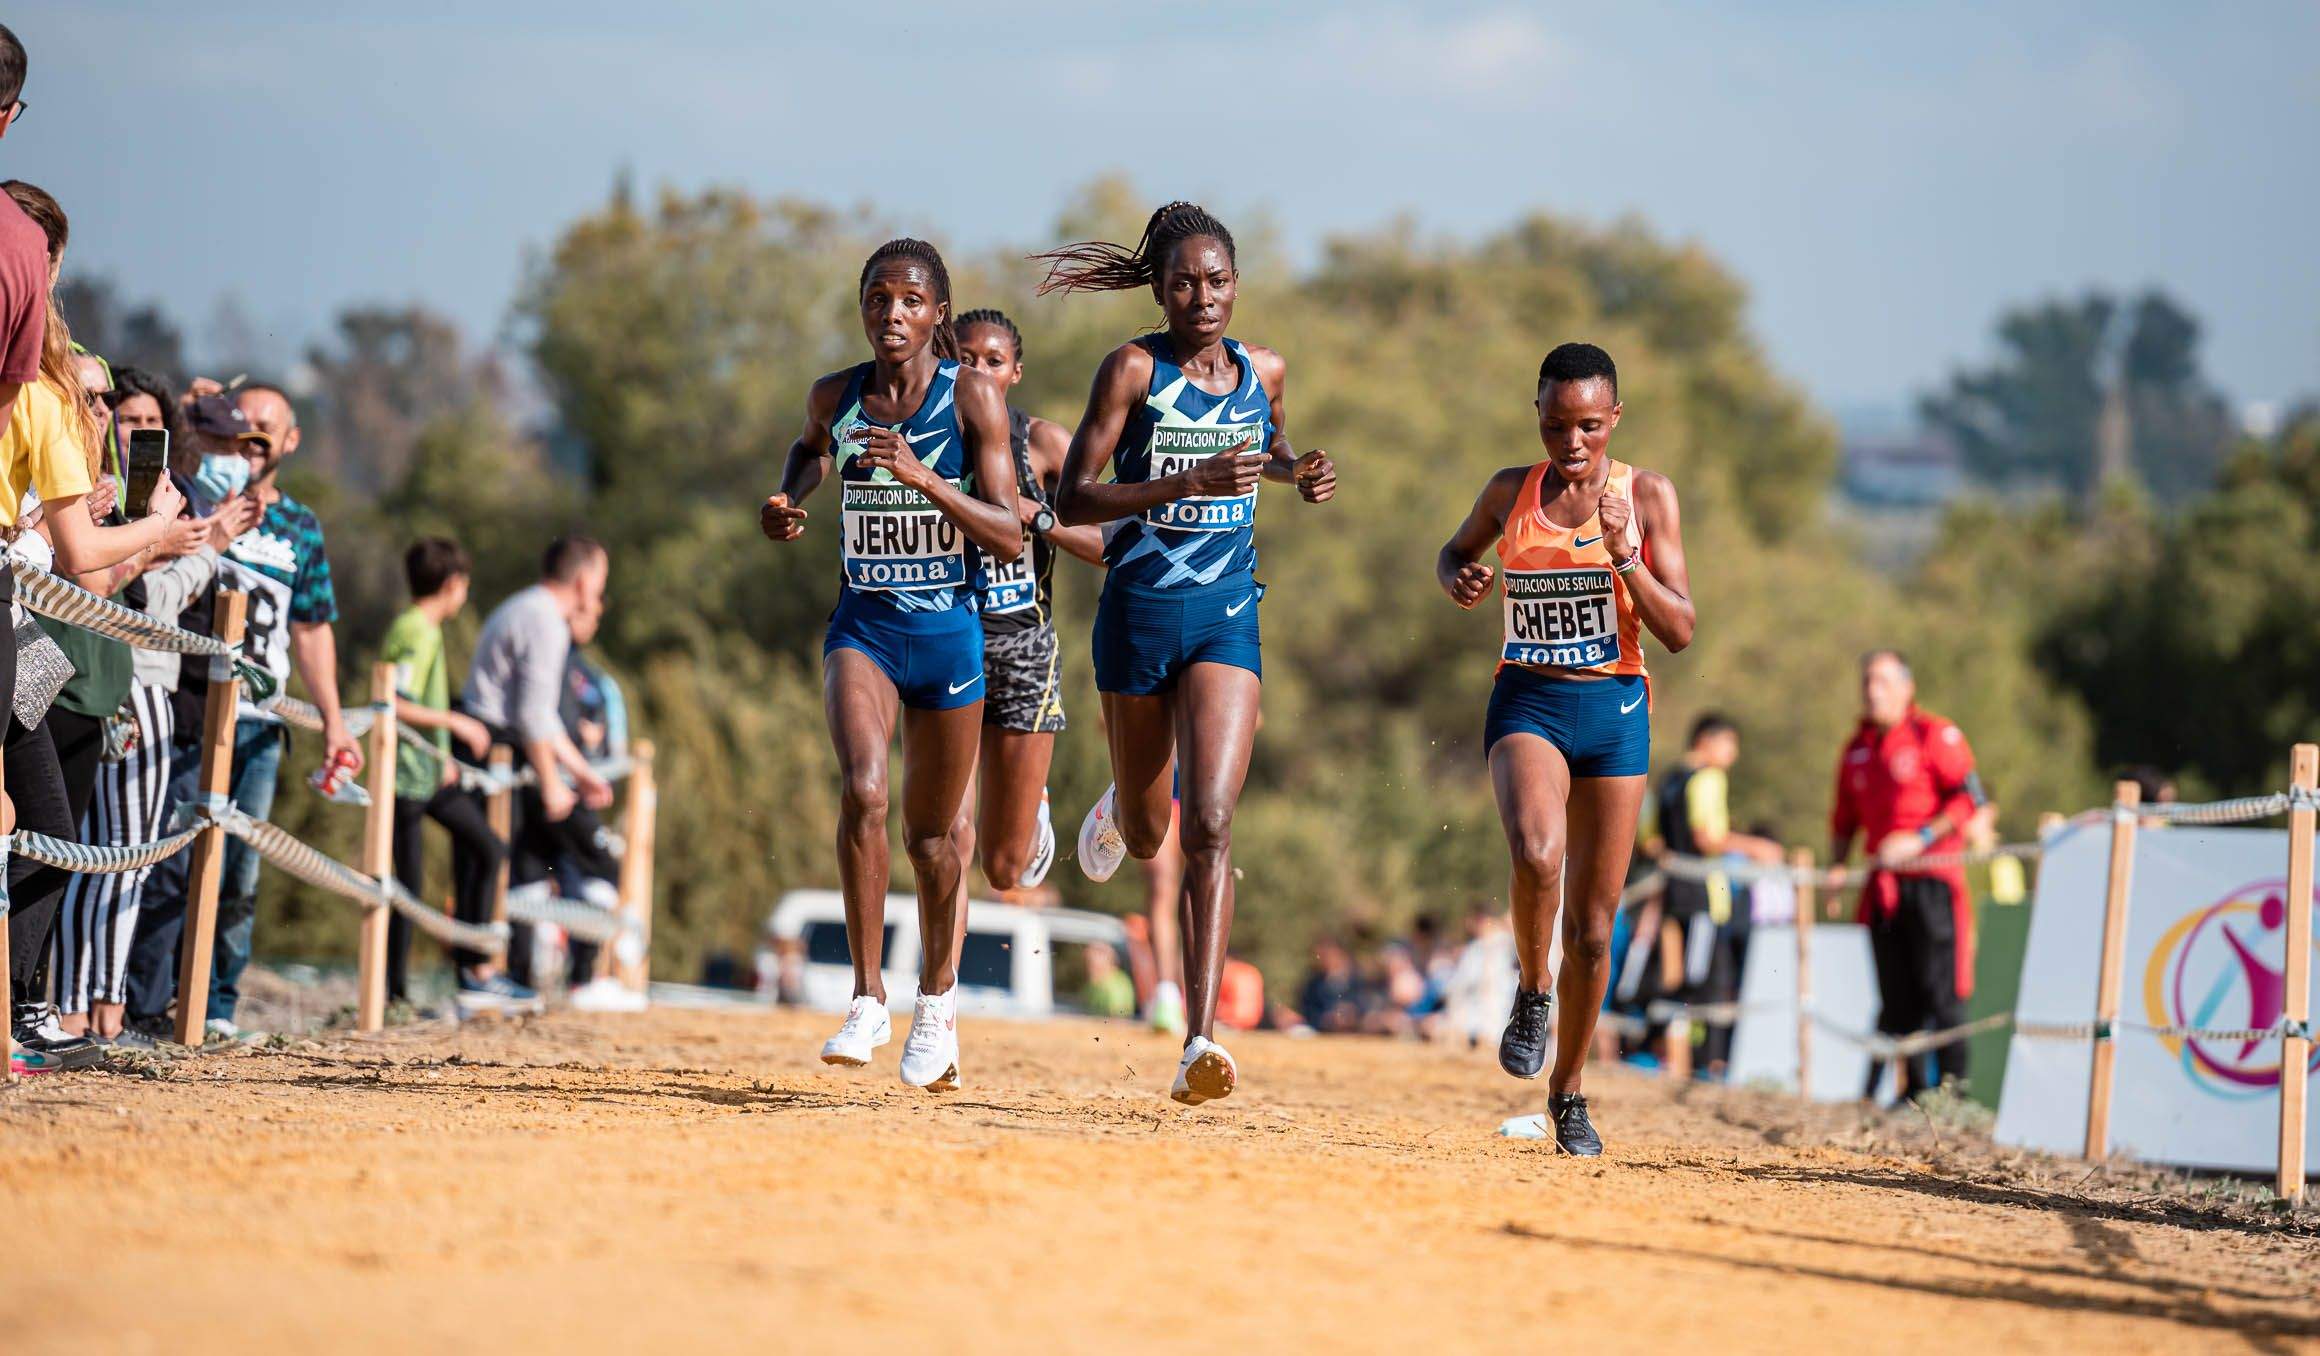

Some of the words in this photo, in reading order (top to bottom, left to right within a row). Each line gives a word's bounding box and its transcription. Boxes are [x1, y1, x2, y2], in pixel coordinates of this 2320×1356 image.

[1156, 430, 1216, 448] DIPUTACION
[1217, 431, 1231, 447] DE
[846, 488, 902, 505] DIPUTACION
[905, 489, 919, 504] DE
[853, 514, 956, 555] JERUTO
[1558, 577, 1571, 591] DE
[1573, 576, 1612, 591] SEVILLA
[1512, 597, 1608, 641] CHEBET
